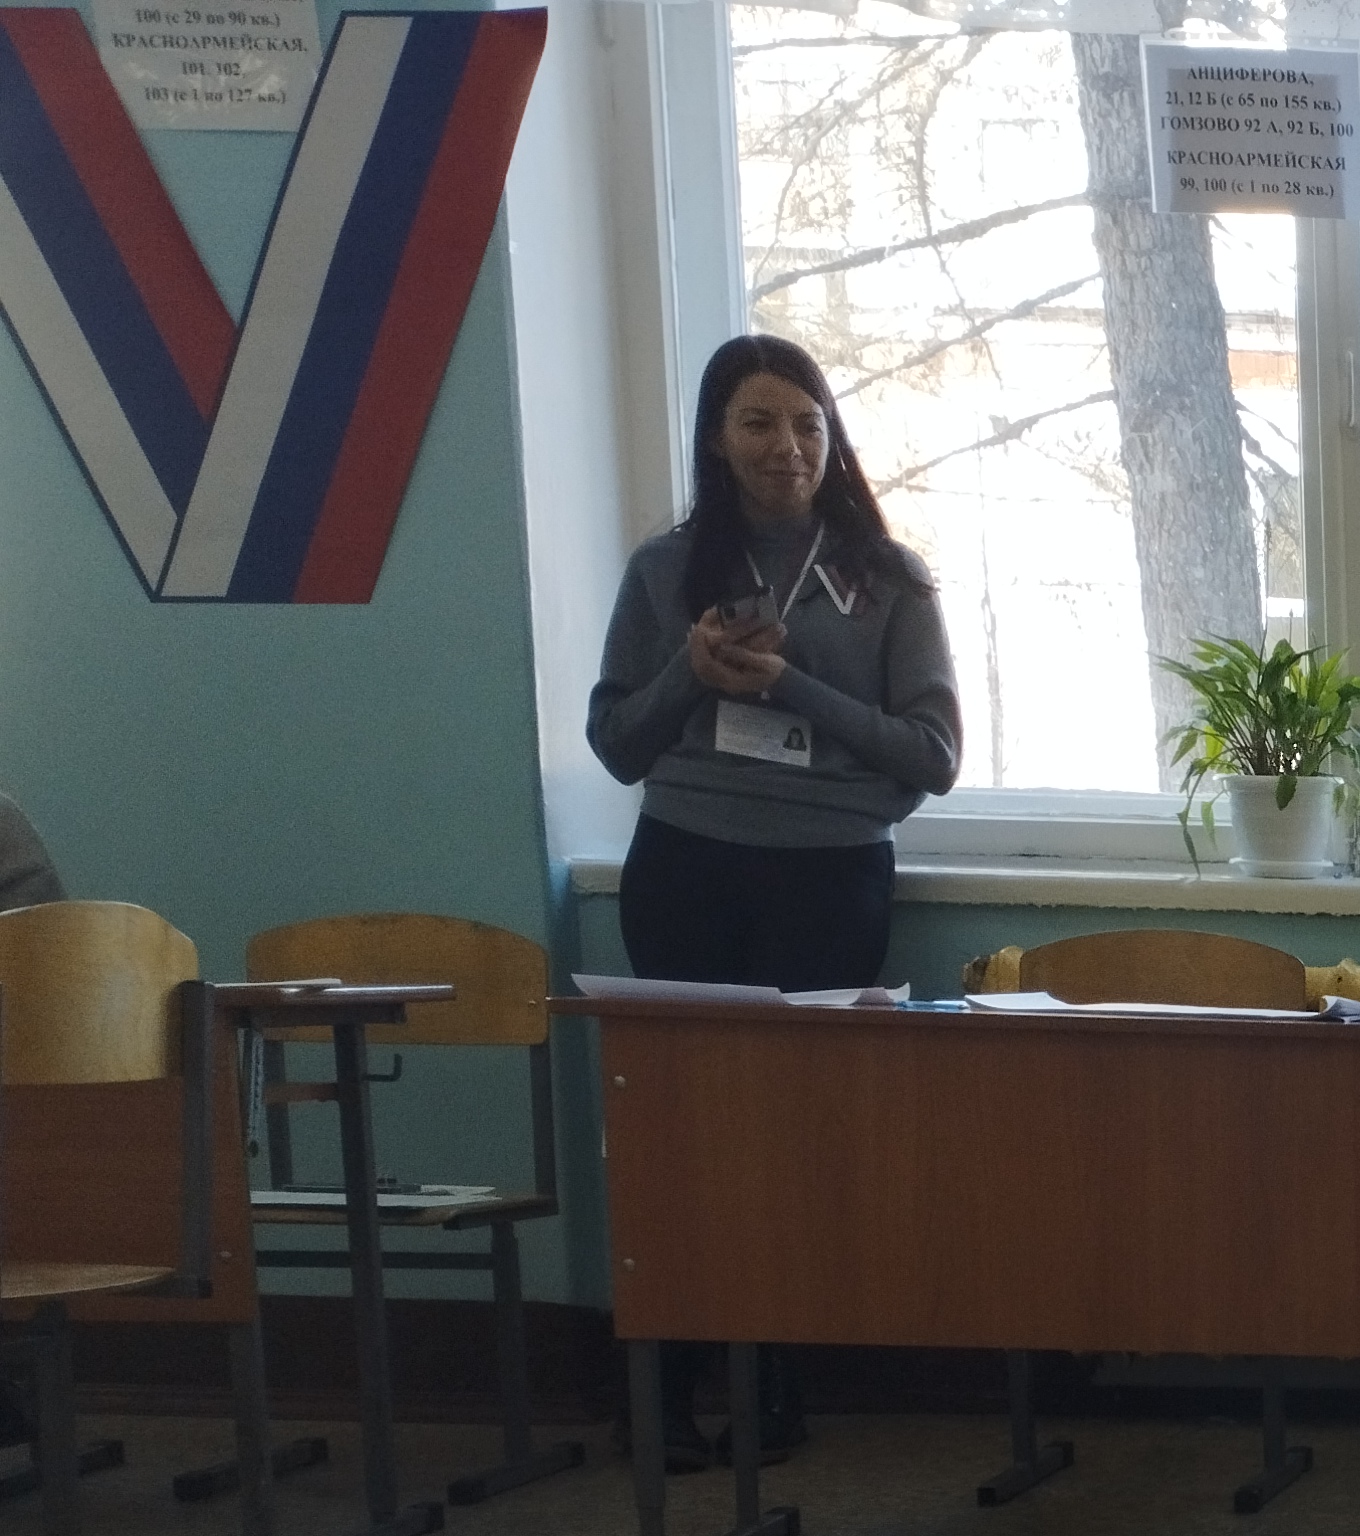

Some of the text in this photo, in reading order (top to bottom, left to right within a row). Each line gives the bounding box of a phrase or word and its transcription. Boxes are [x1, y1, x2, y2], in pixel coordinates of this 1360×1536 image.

[1187, 66, 1314, 86] АНЦИФЕРОВА,
[1165, 91, 1184, 107] 21,
[1188, 92, 1202, 105] 12
[1207, 92, 1217, 106] Б
[1238, 93, 1255, 107] 65
[1260, 97, 1278, 108] по
[1284, 95, 1308, 110] 155
[1160, 116, 1240, 132] ГОМЗОВО
[1244, 119, 1260, 133] 92
[1287, 121, 1304, 135] 92
[1330, 123, 1354, 137] 100
[1167, 150, 1346, 170] КРАСНОАРМЕЙСКАЯ
[1180, 177, 1199, 193] 99,
[1204, 178, 1227, 192] 100
[1250, 179, 1255, 193] 1
[1262, 183, 1279, 194] по
[1284, 181, 1301, 195] 28
